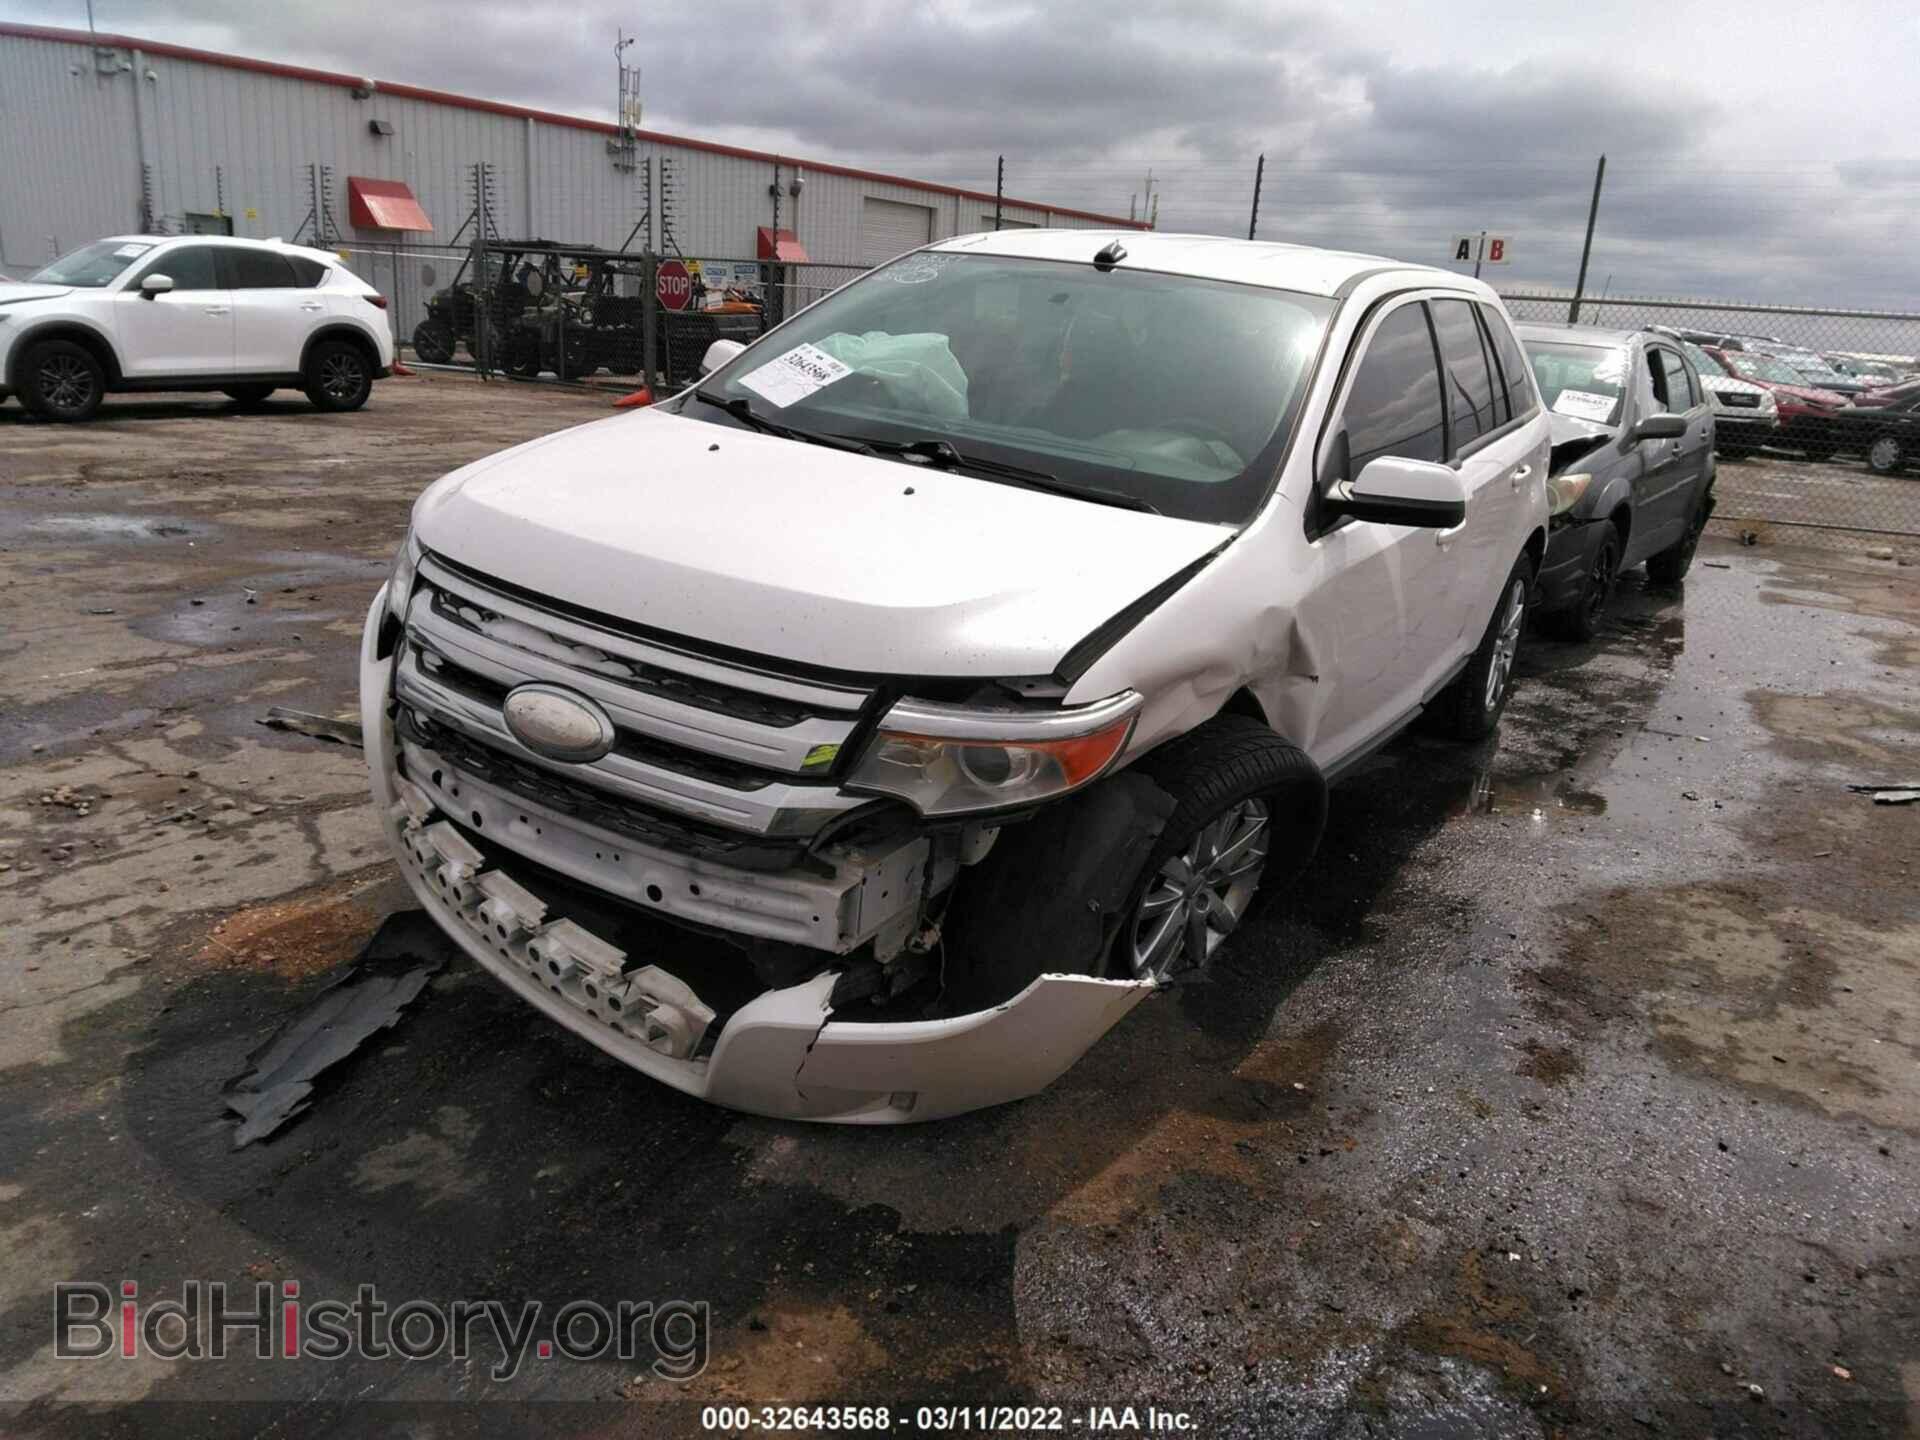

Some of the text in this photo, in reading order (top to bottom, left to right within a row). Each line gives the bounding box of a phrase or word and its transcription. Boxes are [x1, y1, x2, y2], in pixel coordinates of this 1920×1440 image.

[1456, 239, 1504, 260] A B
[659, 275, 688, 295] STOP
